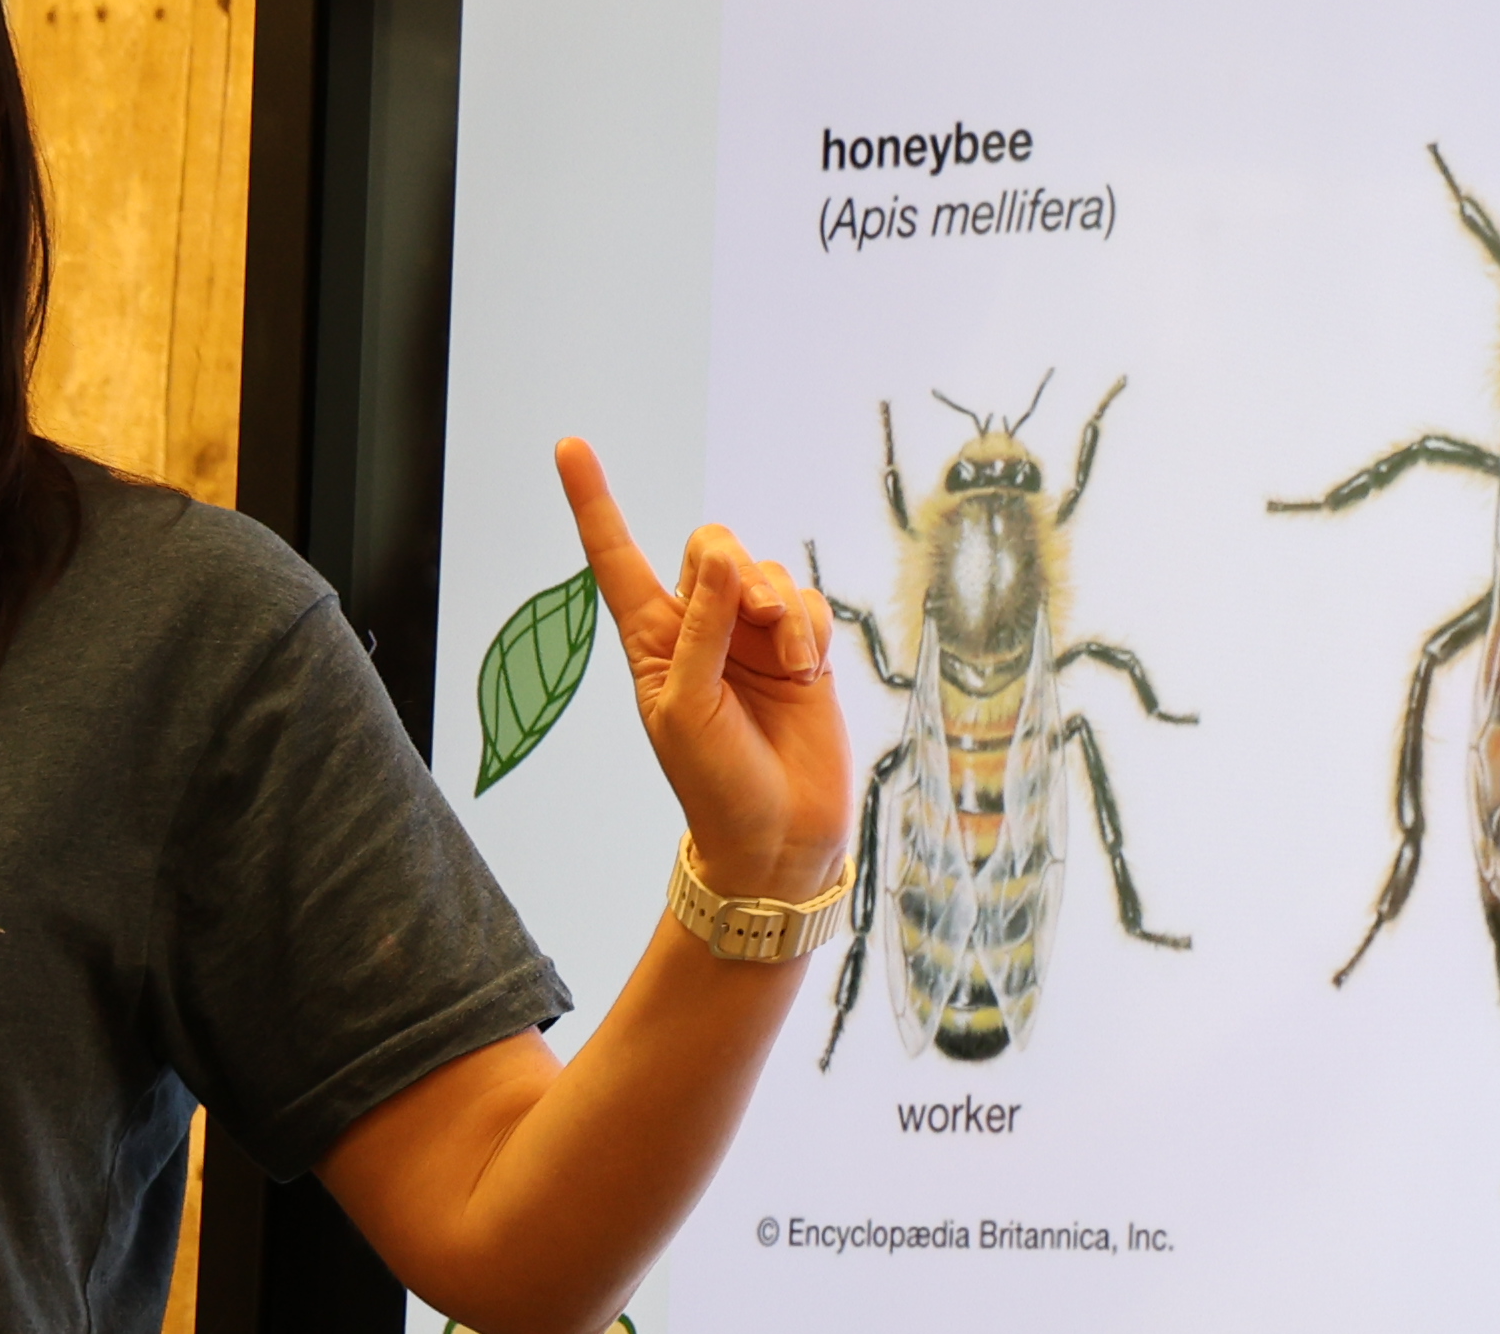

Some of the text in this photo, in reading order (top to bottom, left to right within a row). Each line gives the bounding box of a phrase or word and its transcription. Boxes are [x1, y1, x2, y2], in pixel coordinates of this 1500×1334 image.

[822, 121, 1033, 176] honeybee
[820, 184, 1115, 253] (Apis mellifera)
[898, 1094, 1022, 1133] worker
[788, 1217, 970, 1255] Encyclopædia
[979, 1219, 1118, 1255] Britannica,
[1127, 1222, 1175, 1252] Inc.
